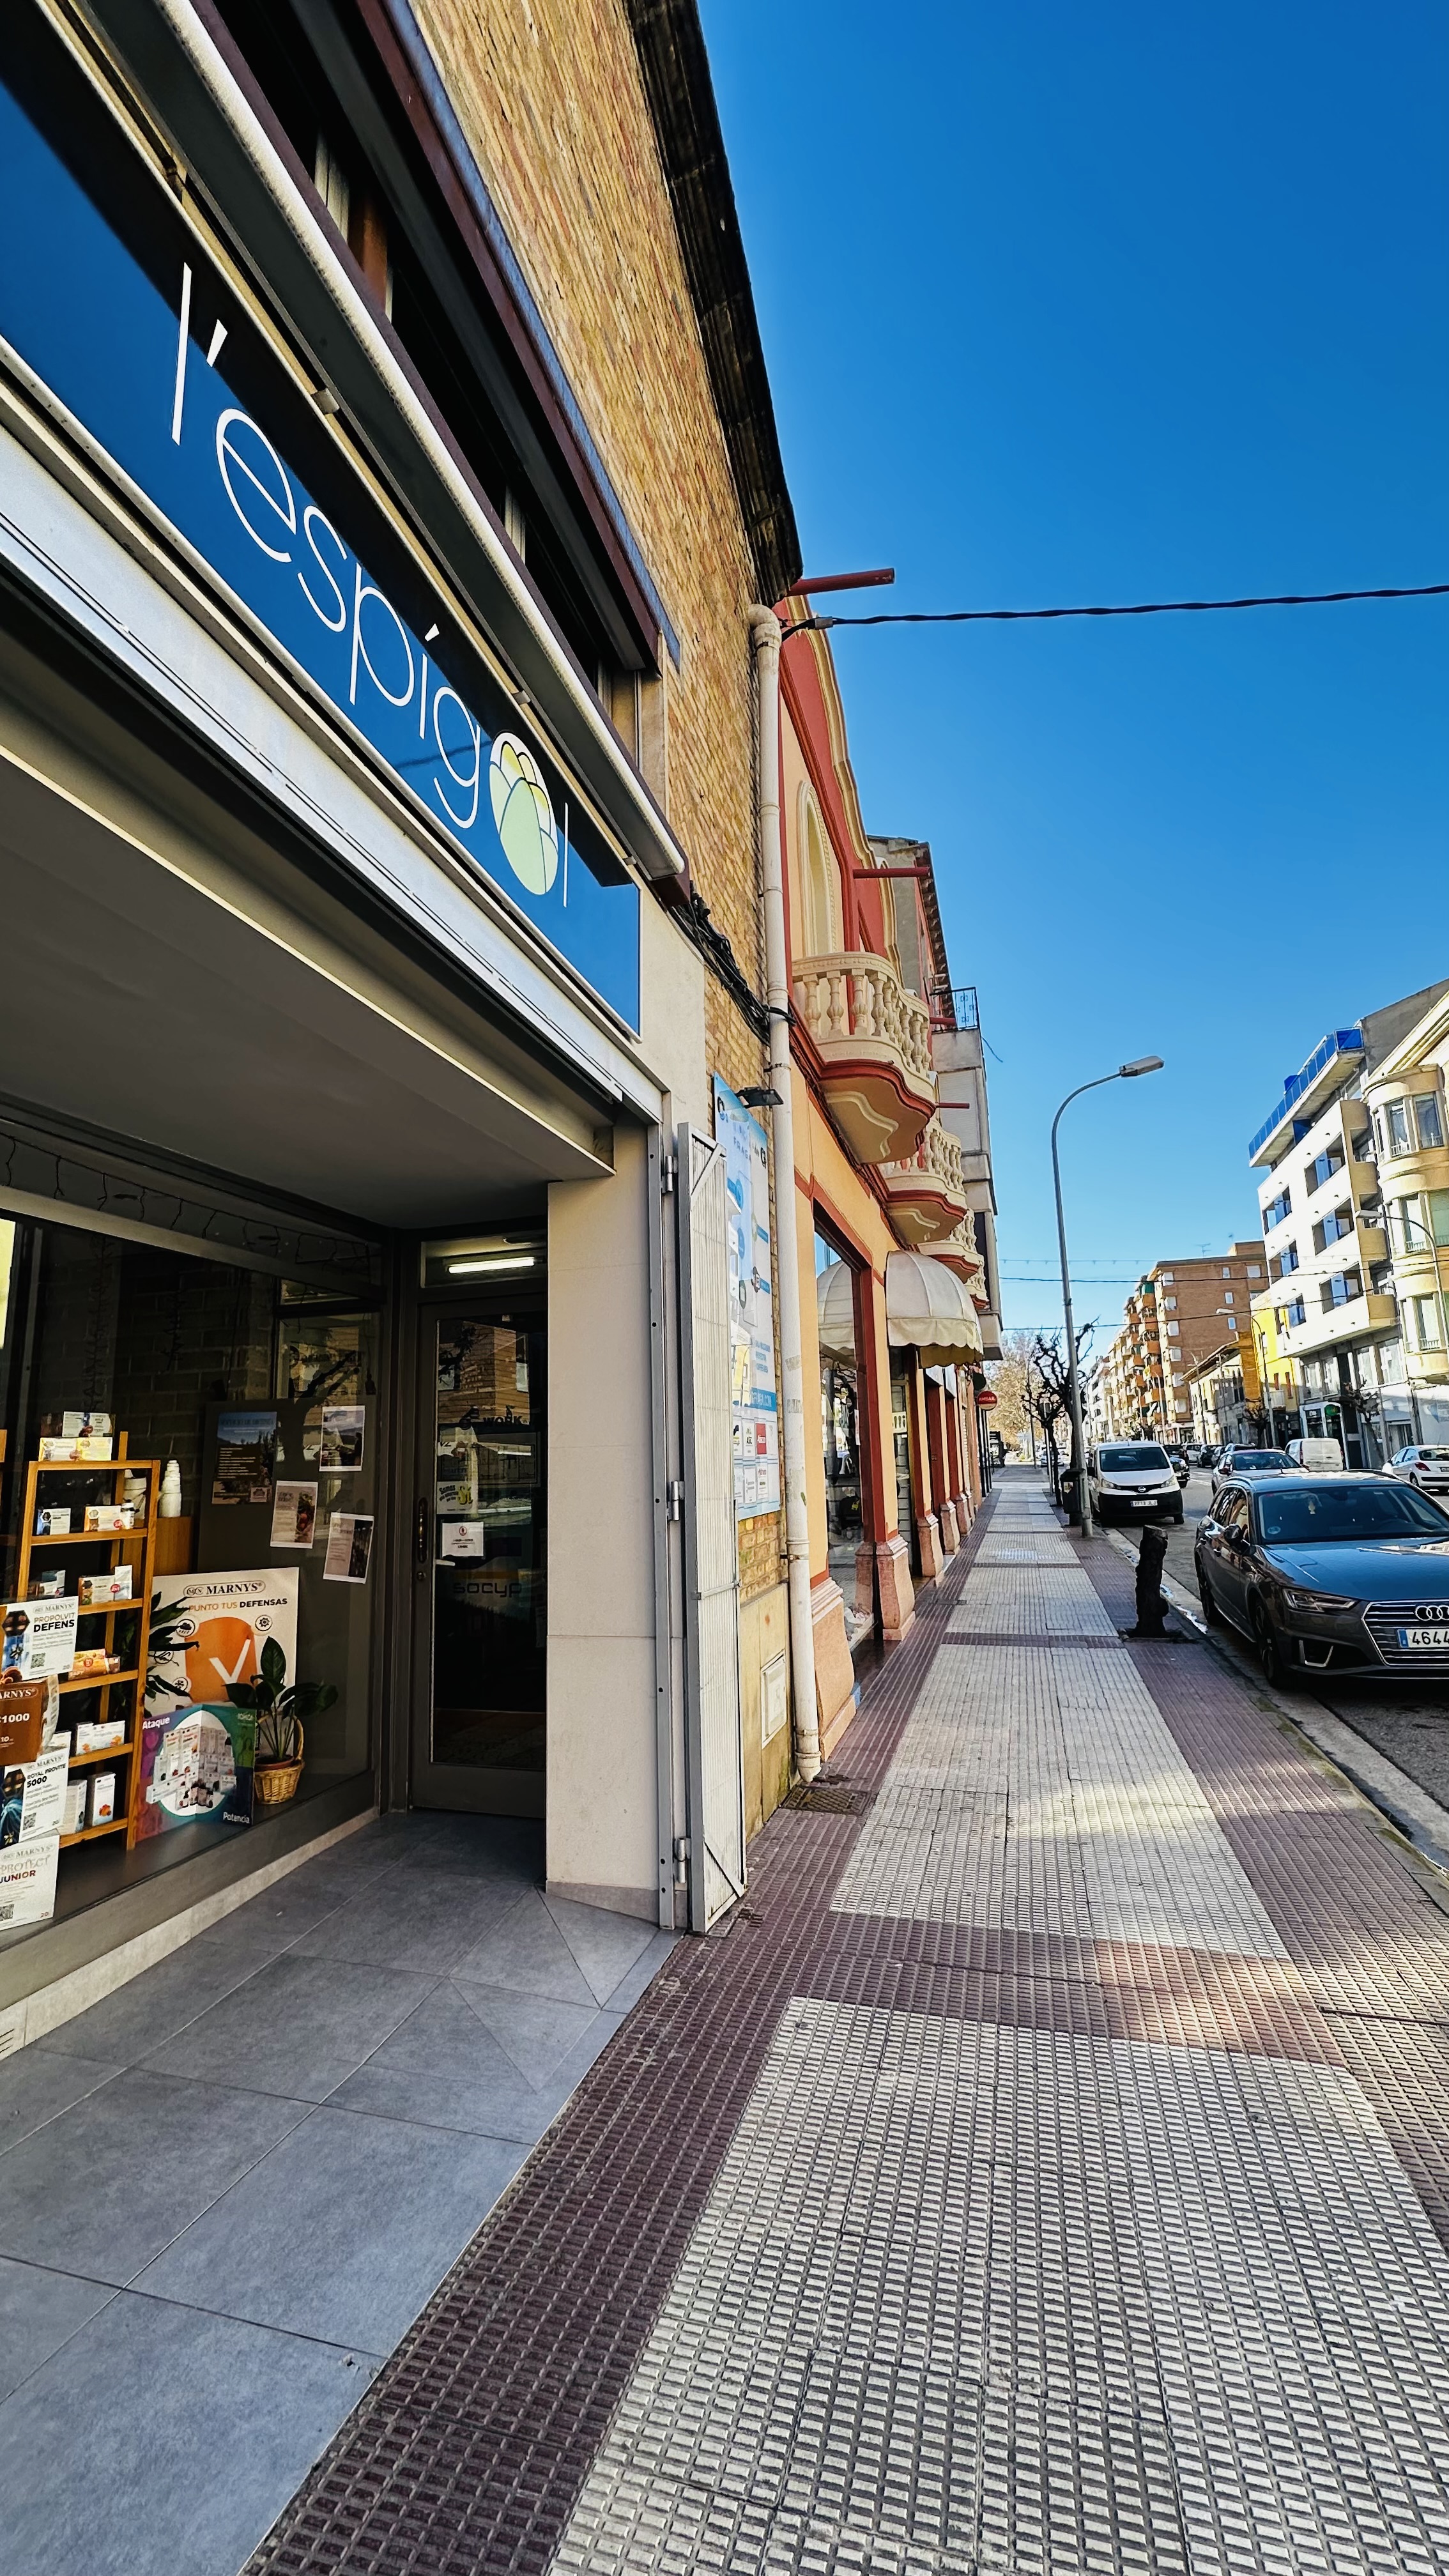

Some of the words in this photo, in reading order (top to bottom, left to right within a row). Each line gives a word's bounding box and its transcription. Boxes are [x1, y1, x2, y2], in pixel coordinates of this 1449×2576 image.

[206, 1581, 258, 1595] MARNYS
[188, 1603, 218, 1612] PUNTO
[240, 1598, 288, 1608] DEFENSAS
[34, 1613, 75, 1623] PROPOLVIT
[34, 1620, 75, 1632] DEFENS
[0, 1713, 30, 1724] 1000
[142, 1716, 170, 1729] Ataque
[27, 1776, 47, 1788] 5000
